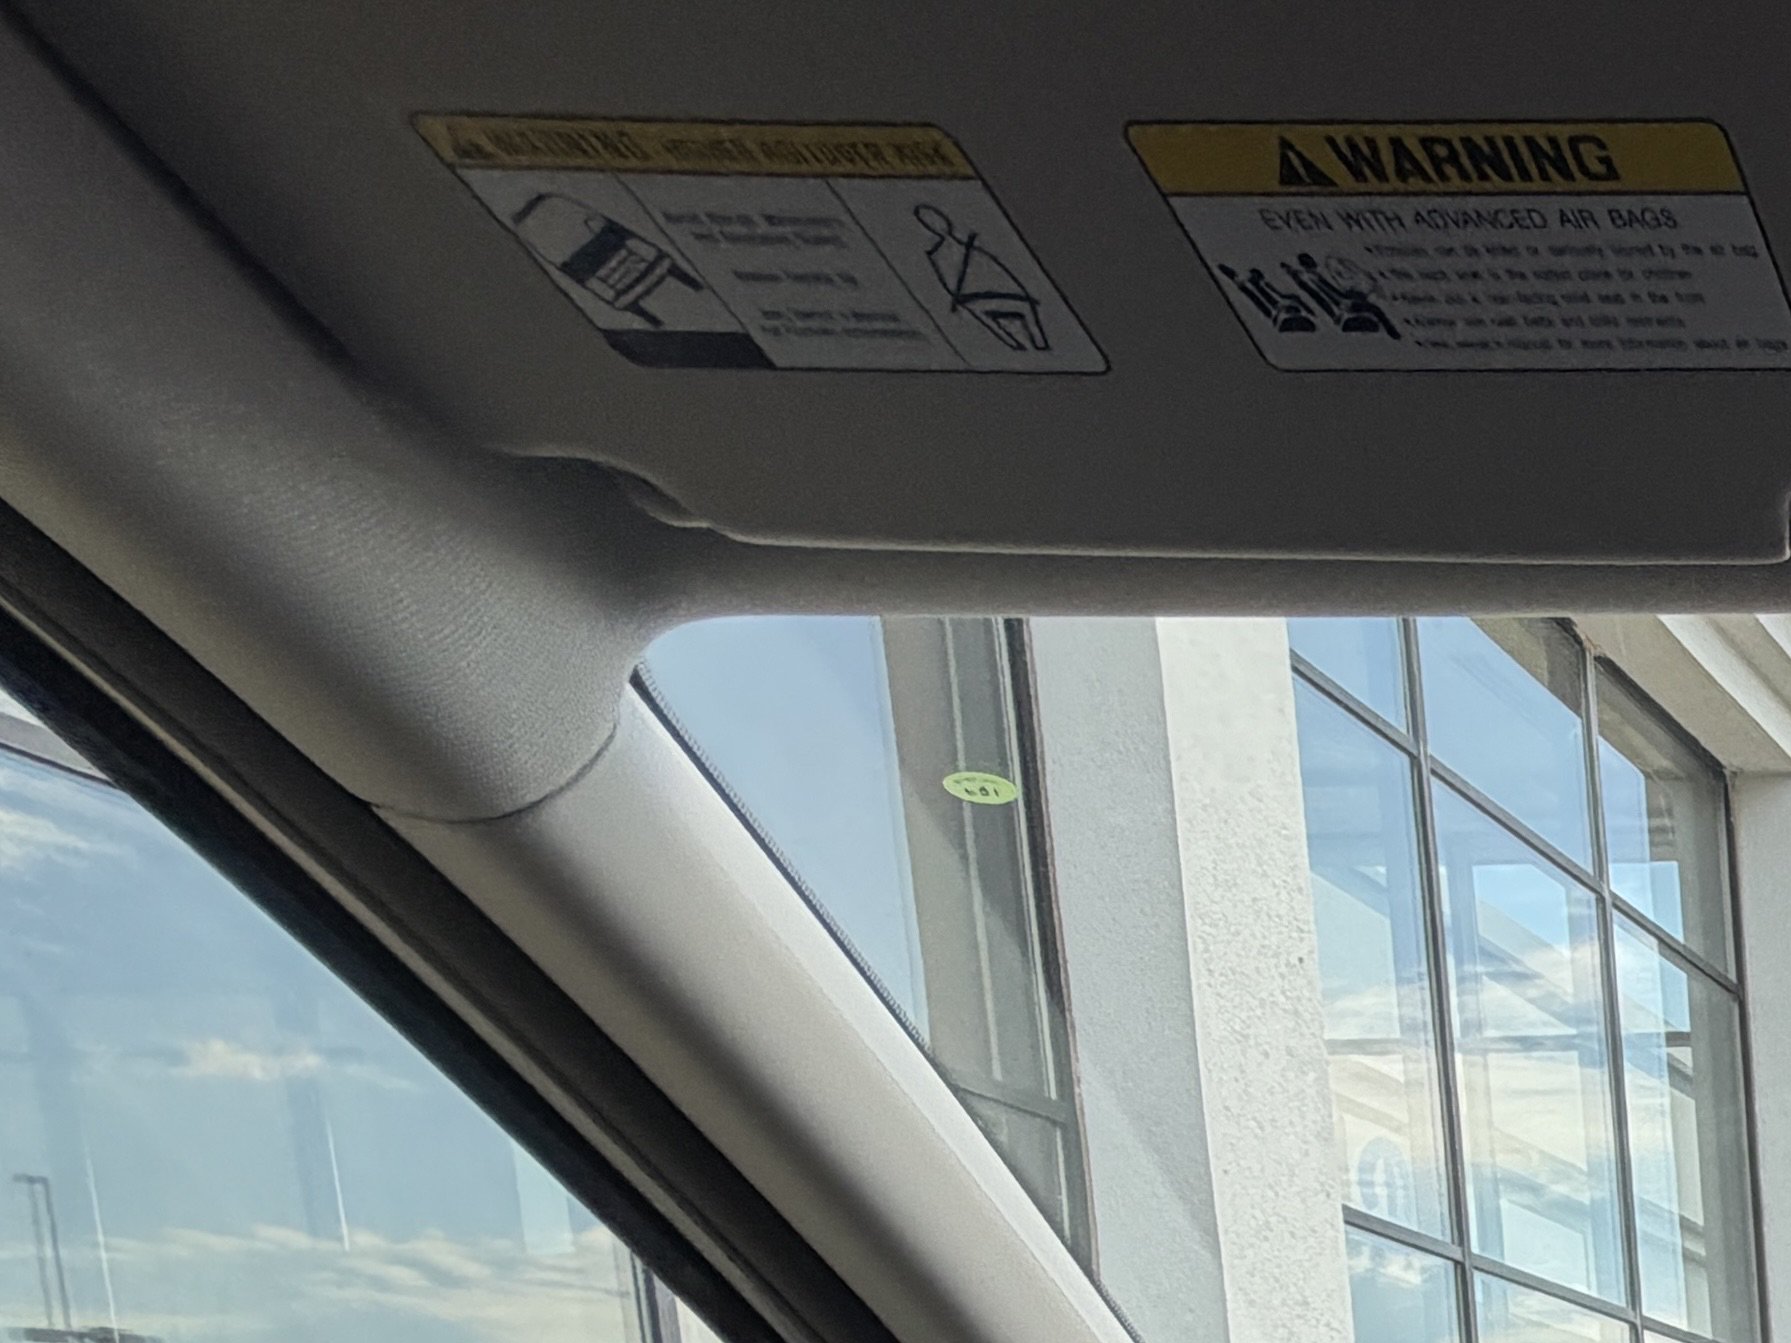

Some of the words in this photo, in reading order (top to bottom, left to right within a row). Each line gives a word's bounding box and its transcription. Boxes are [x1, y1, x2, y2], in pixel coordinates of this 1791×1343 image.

[1326, 134, 1620, 184] WARNING
[1258, 208, 1333, 231] EVEN
[1337, 208, 1407, 231] WITH
[1414, 208, 1548, 230] ADVANCED
[1559, 208, 1600, 230] AIR
[1607, 208, 1678, 229] BAGS
